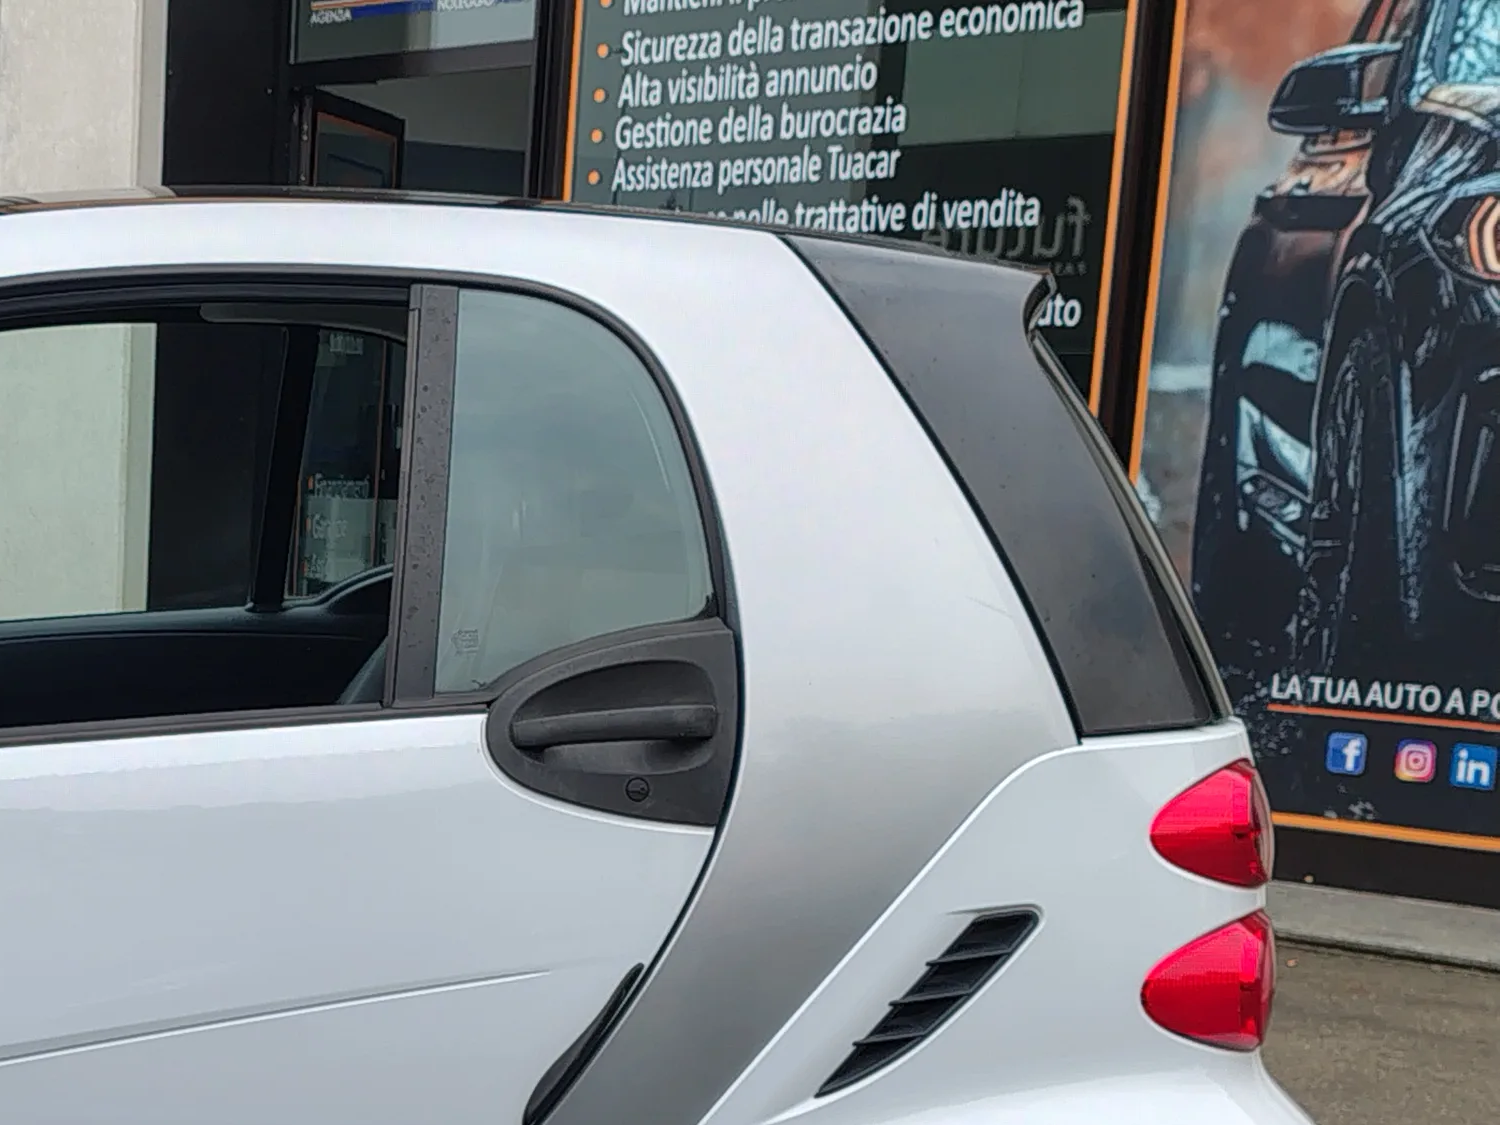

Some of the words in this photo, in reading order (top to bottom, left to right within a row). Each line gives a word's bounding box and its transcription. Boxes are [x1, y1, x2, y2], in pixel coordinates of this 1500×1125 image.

[621, 30, 722, 66] Sicurezza
[728, 16, 784, 55] della
[790, 6, 933, 51] transazione
[939, 0, 1084, 38] economica
[617, 70, 662, 108] Alta
[667, 61, 760, 104] visibilità
[765, 53, 878, 97] annuncio
[615, 112, 712, 150] Gestione
[718, 105, 774, 144] della
[780, 96, 906, 141] burocrazia
[611, 156, 713, 192] Assistenza
[718, 144, 822, 196] personale
[827, 145, 901, 182] Tuacar
[795, 195, 906, 233] trattative
[912, 190, 938, 230] di
[943, 187, 1041, 228] vendita
[1037, 293, 1082, 327] uto
[1271, 673, 1301, 700] LA
[1308, 676, 1361, 706] TUA
[1364, 681, 1442, 713] AUTO
[1444, 687, 1466, 715] A
